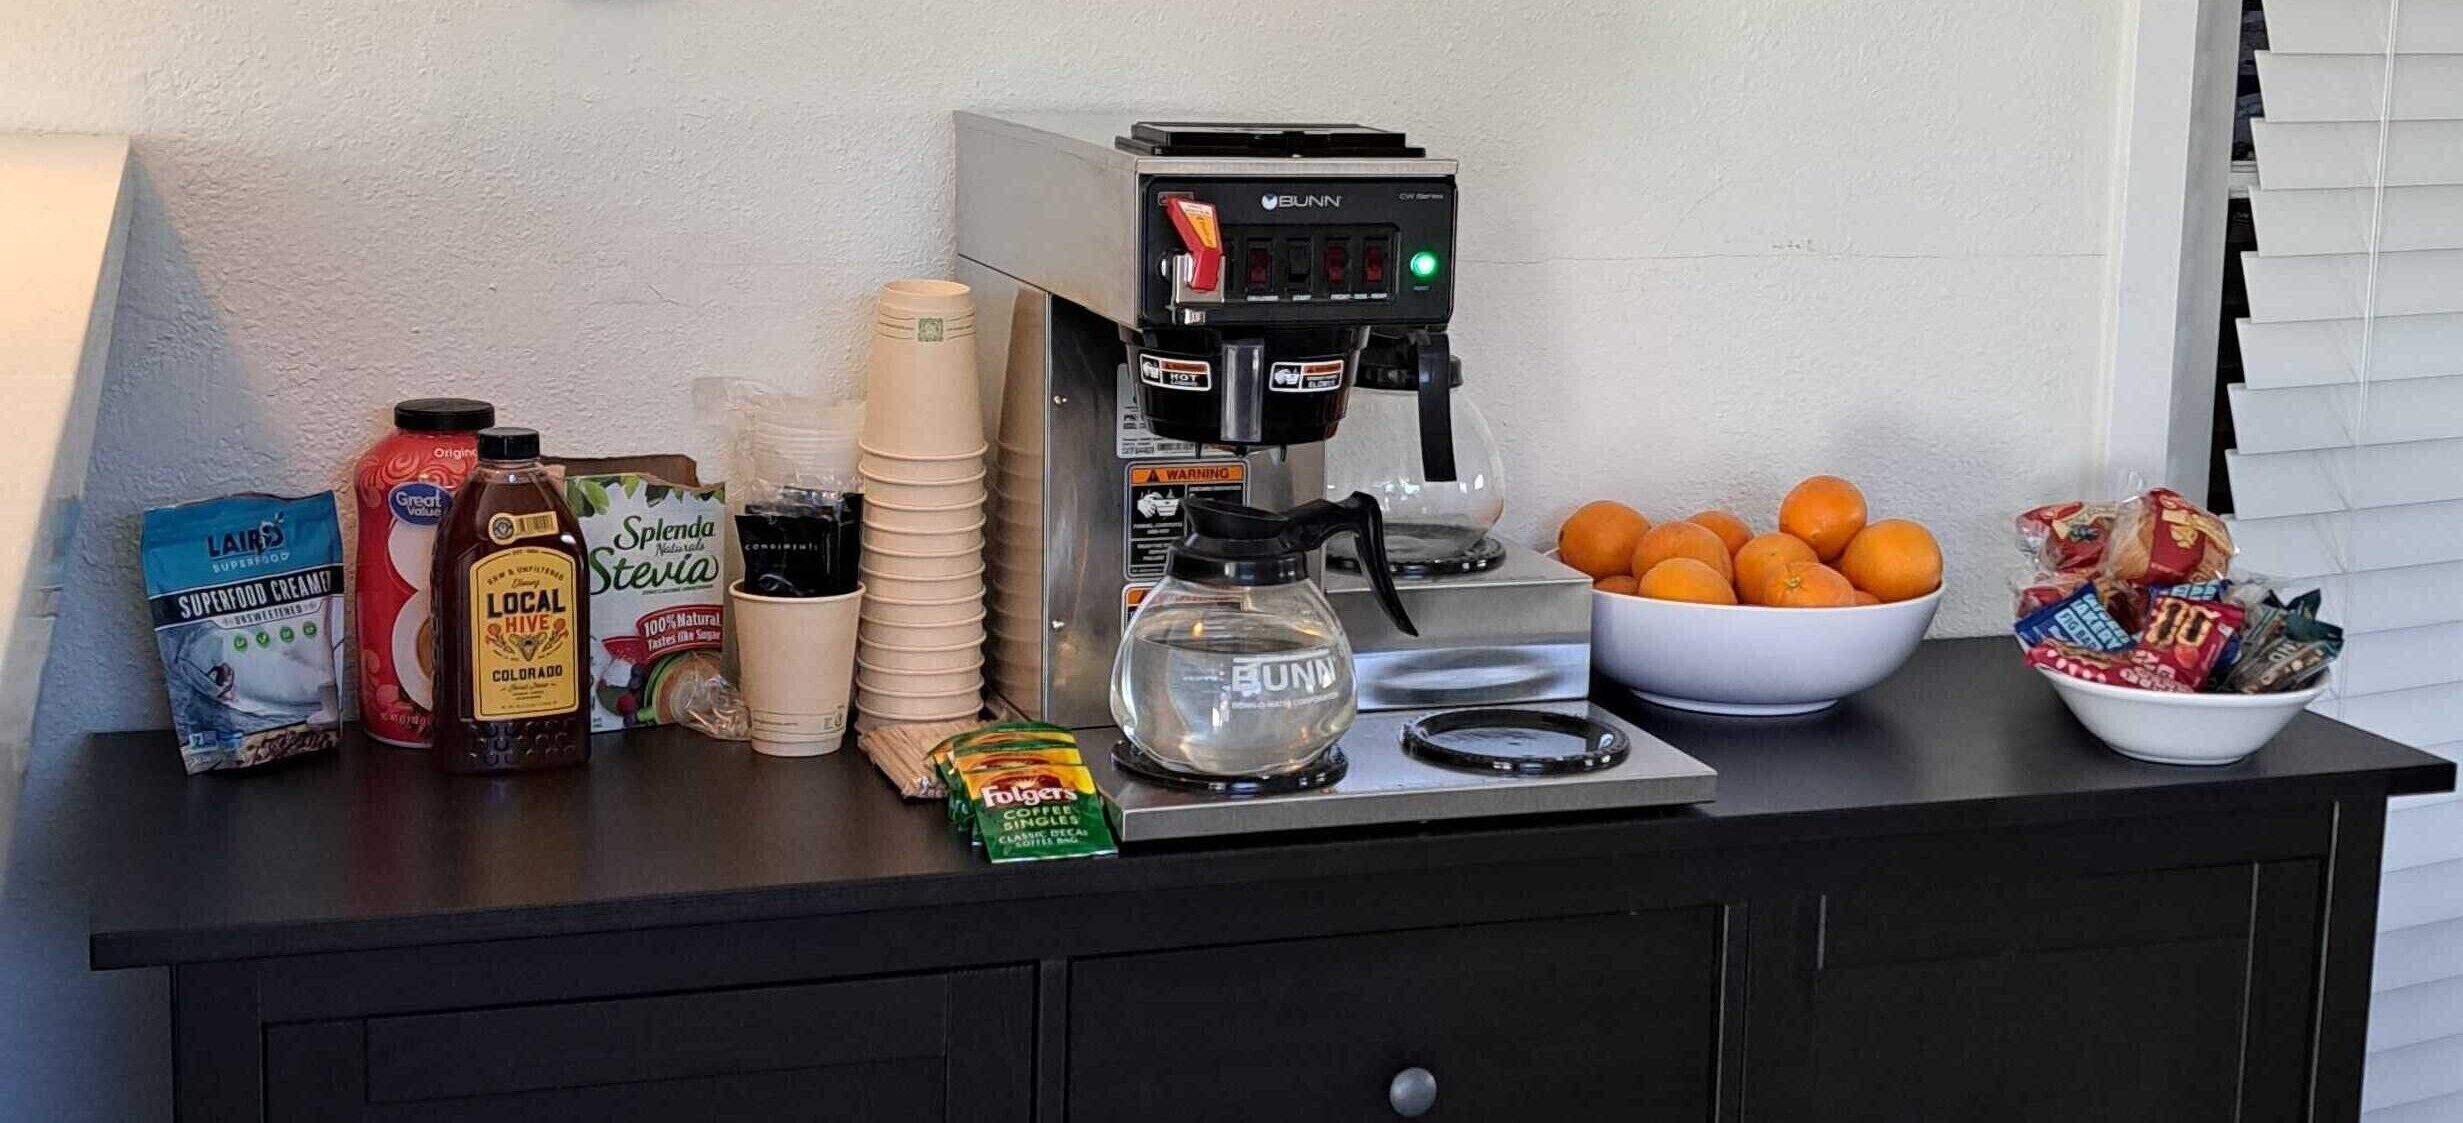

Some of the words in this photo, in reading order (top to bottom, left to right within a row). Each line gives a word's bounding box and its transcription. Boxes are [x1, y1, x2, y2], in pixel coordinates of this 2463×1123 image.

[1279, 195, 1340, 208] BUNN
[1170, 373, 1198, 381] HOT
[1166, 468, 1230, 480] WARNING
[396, 488, 441, 507] Great
[614, 515, 715, 550] Splenda
[655, 539, 706, 556] Naturals
[212, 551, 291, 573] SUPERFOOD
[590, 547, 719, 595] Stevia
[517, 565, 564, 580] UNFILTERED
[178, 583, 268, 619] SUPERFOOD
[487, 589, 566, 618] LOCAL
[505, 615, 550, 633] HIVE
[644, 614, 676, 638] 100%
[677, 612, 720, 627] Natural
[2061, 613, 2079, 630] FIG
[493, 665, 563, 682] COLORADO
[1232, 657, 1336, 693] BUNN
[981, 786, 1077, 808] Folgers
[1003, 806, 1072, 820] COFFEE
[1003, 816, 1079, 831] SINGLES
